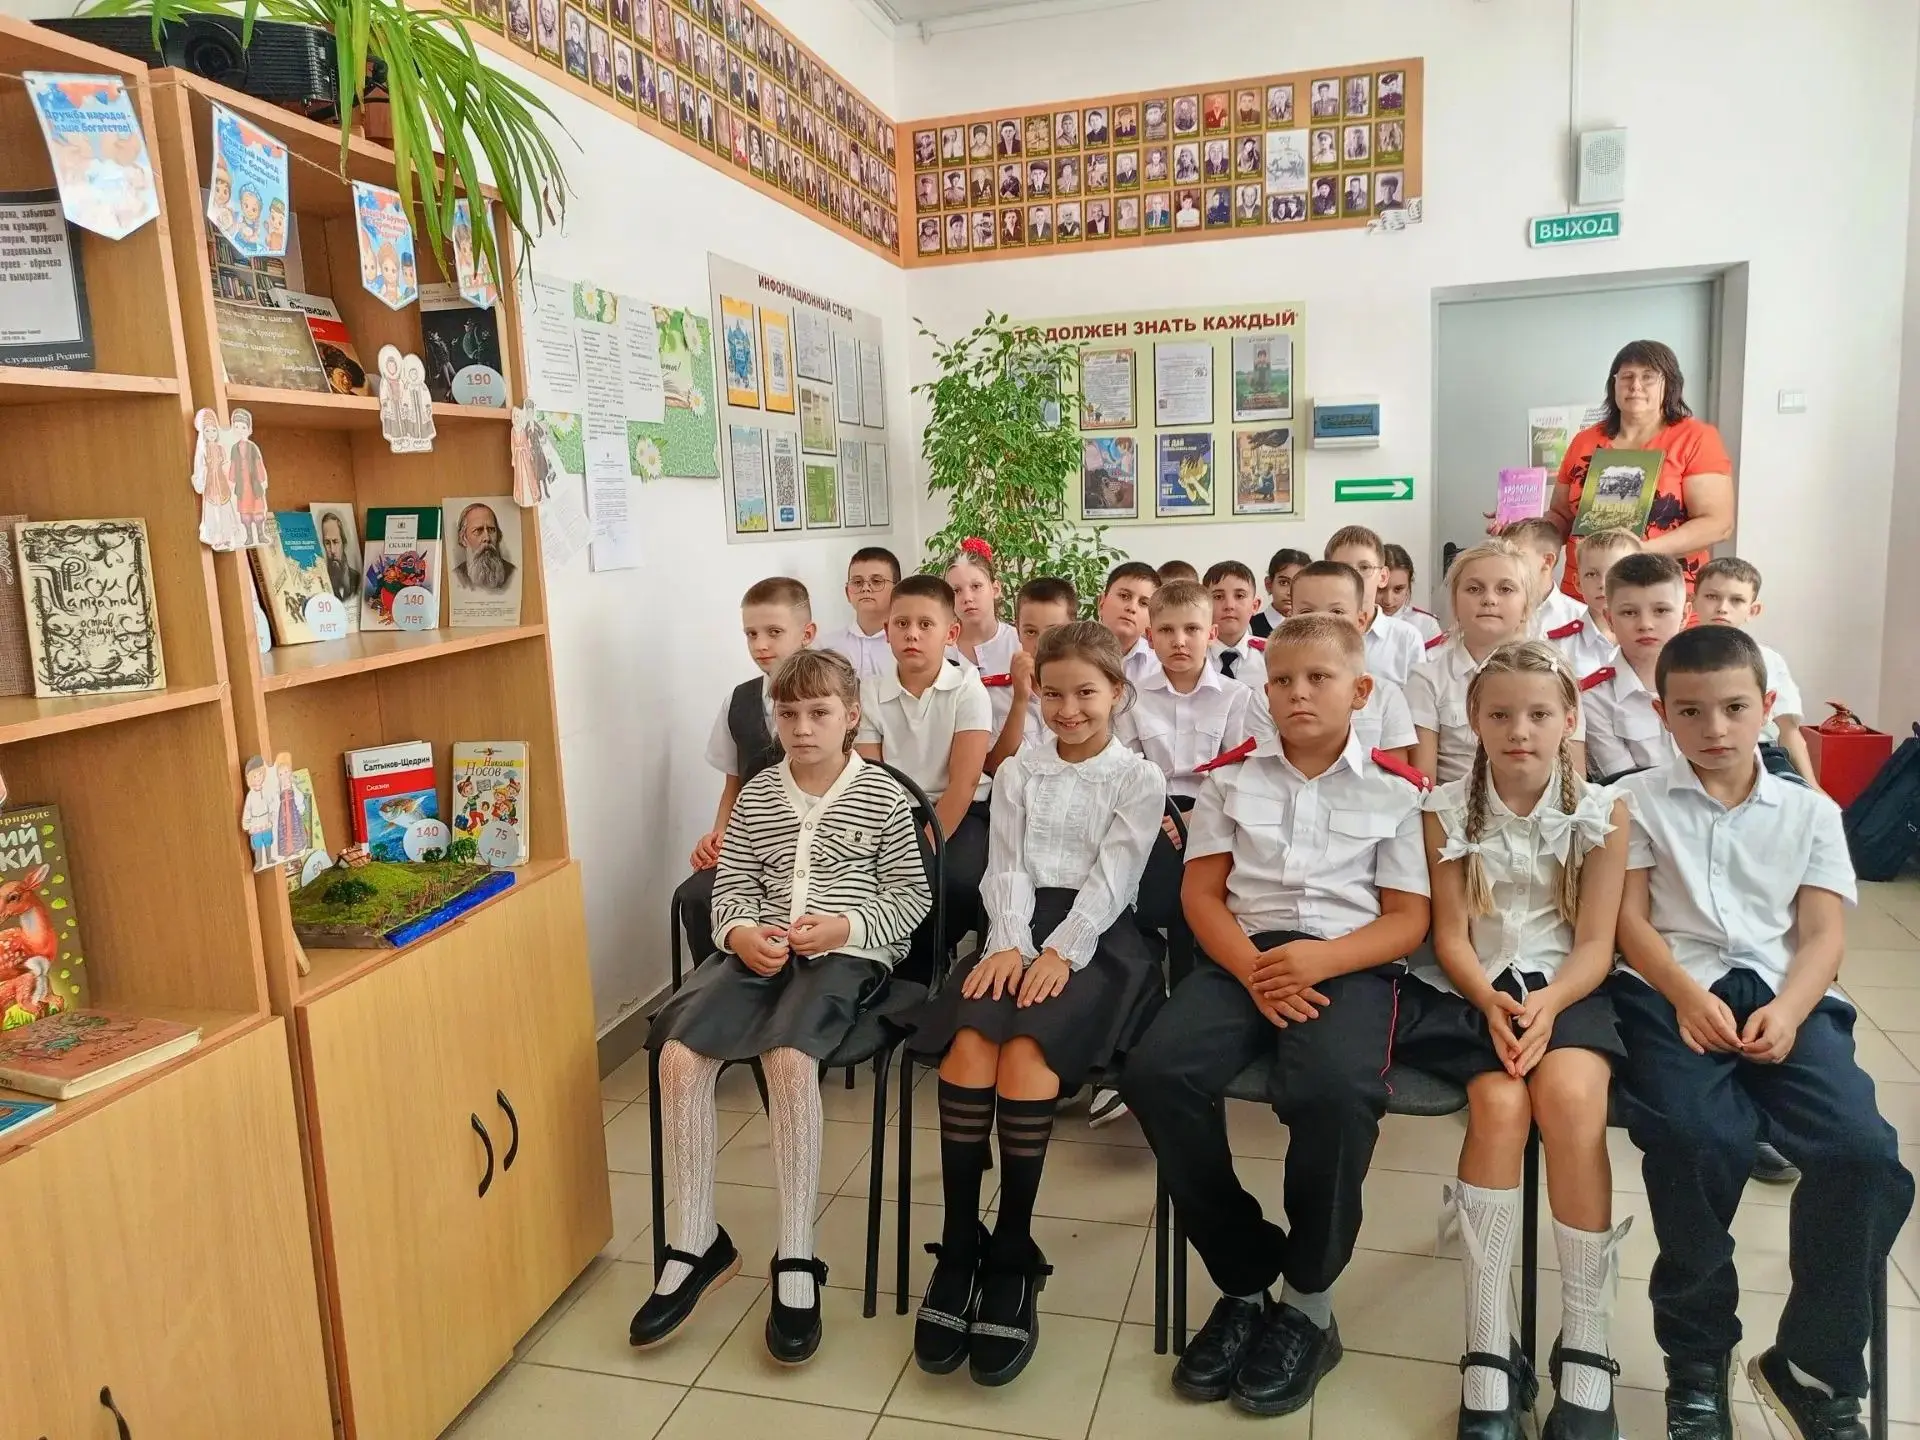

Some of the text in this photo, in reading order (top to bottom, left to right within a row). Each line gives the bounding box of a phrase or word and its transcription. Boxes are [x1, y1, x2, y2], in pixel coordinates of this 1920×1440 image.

[87, 110, 126, 122] народов
[240, 164, 267, 188] России!
[1540, 216, 1614, 239] ВЫХОД
[758, 274, 853, 323] ИНФОРМАЦИОННЫЙ СТЕНД
[1045, 322, 1127, 343] ДОЛЖЕН
[1133, 318, 1197, 336] ЗНАТЬ
[1203, 309, 1296, 331] КАЖДЫЙ
[466, 373, 492, 386] 190
[471, 395, 493, 405] лет
[403, 594, 425, 605] 140
[318, 601, 332, 613] 90
[402, 615, 423, 624] лет
[363, 756, 431, 773] Салтыков-Щедрин
[483, 756, 515, 767] Николай
[464, 760, 502, 777] Носов
[366, 783, 390, 792] Сказки
[416, 826, 440, 838] 140
[495, 828, 509, 841] 75
[486, 848, 508, 859] лет
